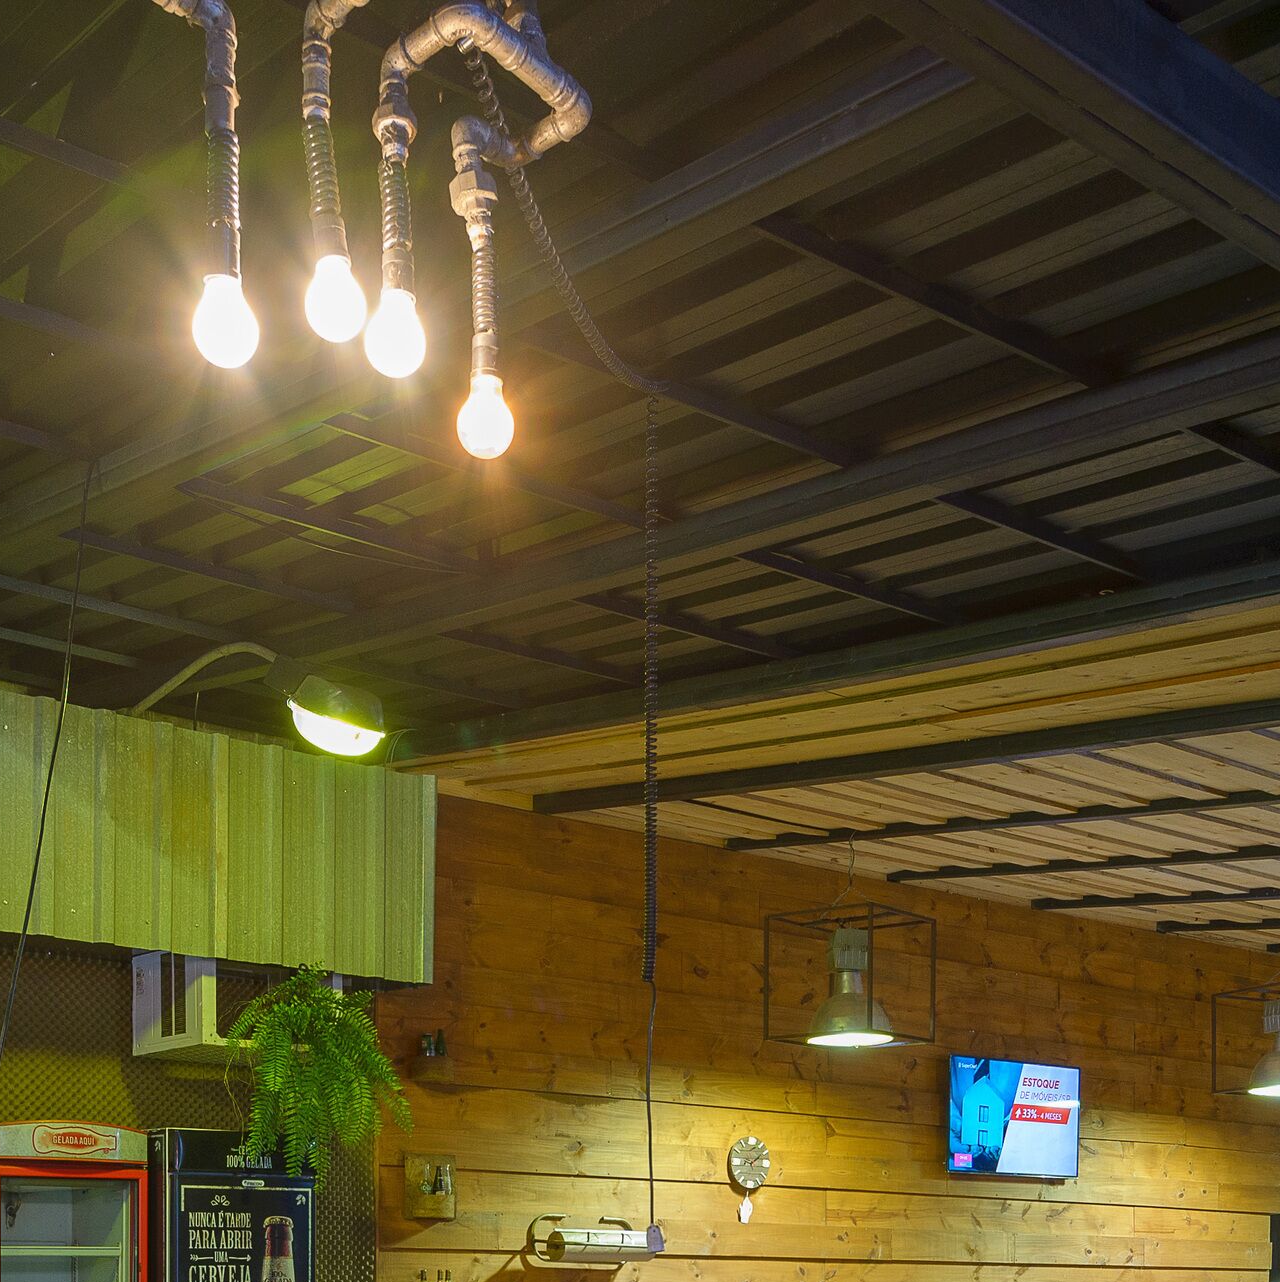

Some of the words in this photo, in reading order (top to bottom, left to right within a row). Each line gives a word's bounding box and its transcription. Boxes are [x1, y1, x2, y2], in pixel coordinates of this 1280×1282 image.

[1022, 1077, 1060, 1090] ESTOQUE
[1020, 1091, 1030, 1099] DE
[1021, 1108, 1037, 1119] 33%
[52, 1135, 79, 1145] GELADA
[79, 1137, 95, 1146] AQUI
[226, 1154, 245, 1168] 100%
[188, 1211, 218, 1228] NUNCA
[219, 1210, 224, 1228] É
[225, 1212, 252, 1228] TARDE
[188, 1229, 217, 1249] PARA
[220, 1230, 253, 1250] ABRIR
[214, 1251, 229, 1262] UMA
